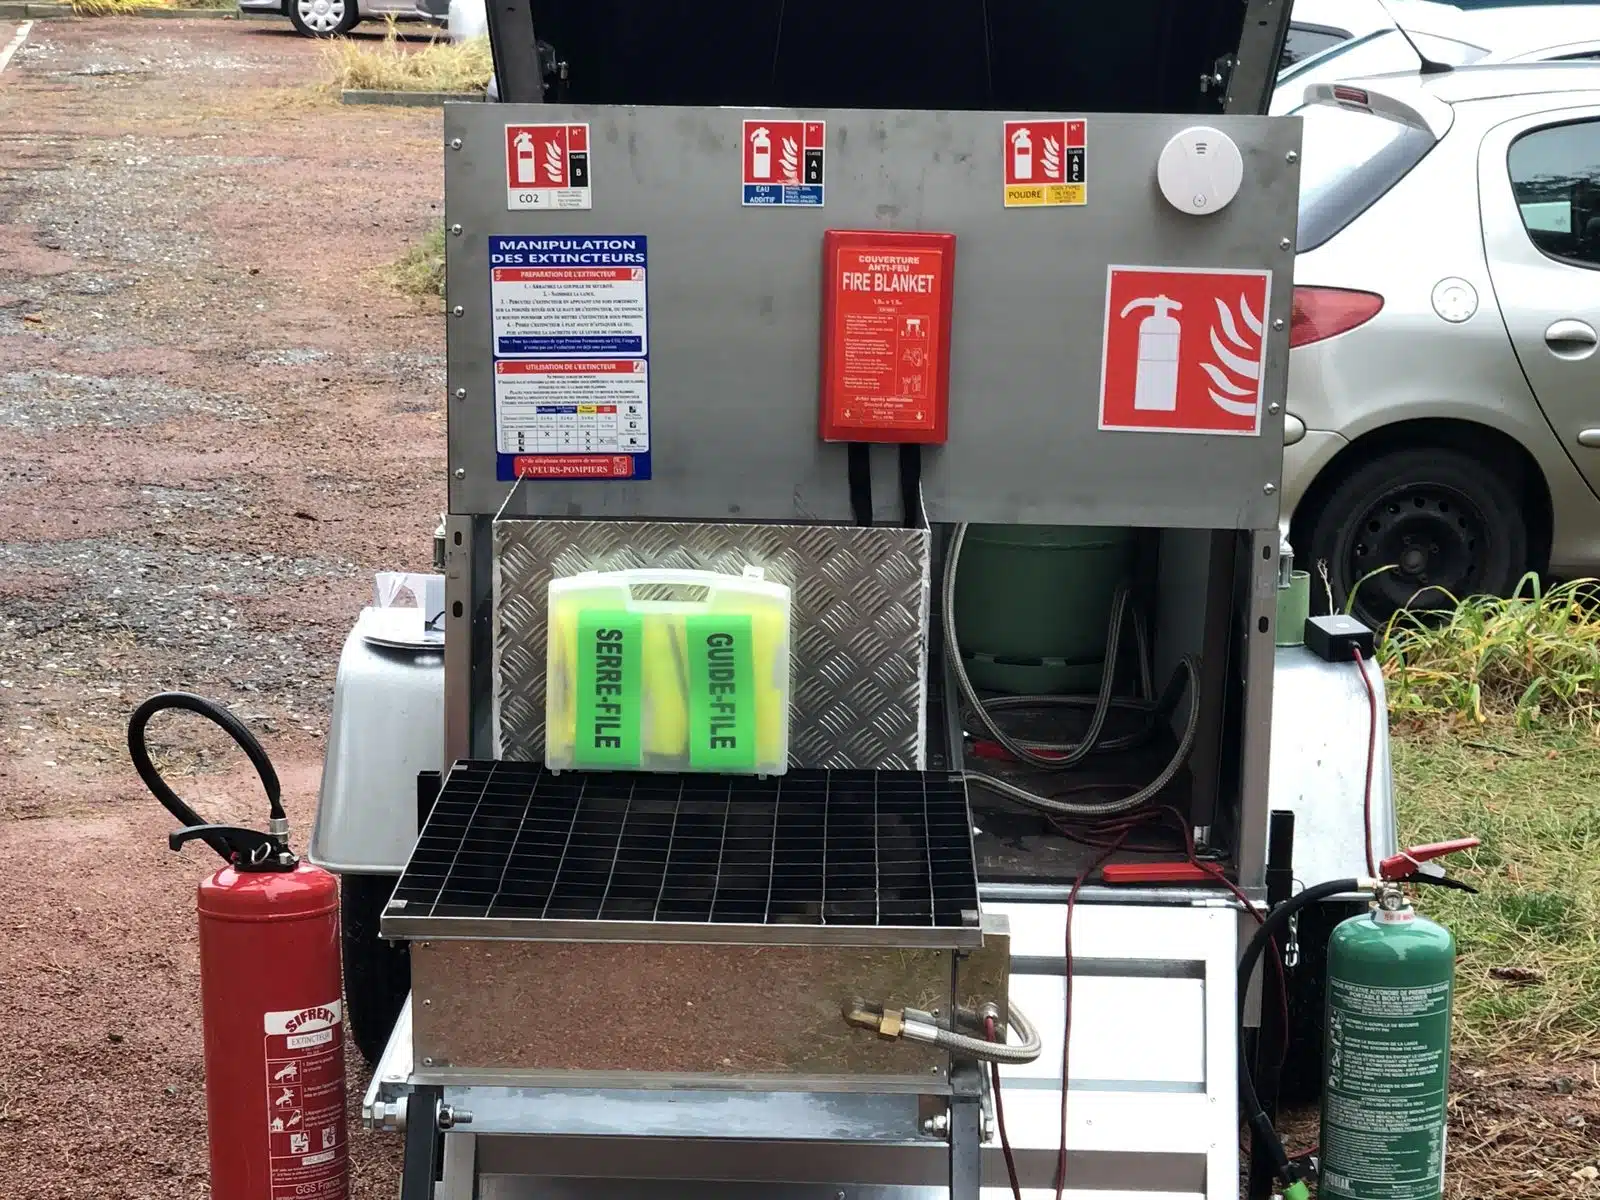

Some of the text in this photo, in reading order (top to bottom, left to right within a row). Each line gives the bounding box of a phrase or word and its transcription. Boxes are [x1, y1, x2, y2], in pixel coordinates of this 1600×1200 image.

[1072, 155, 1079, 163] A
[810, 160, 818, 168] A
[1072, 164, 1079, 172] B
[576, 168, 582, 176] B
[810, 171, 817, 180] B
[1072, 173, 1079, 182] C
[1008, 190, 1041, 198] POUDRE
[519, 194, 540, 204] CO2
[500, 240, 636, 250] MANIPULATION
[492, 253, 645, 264] DES EXTINCTEURS
[858, 255, 920, 264] COUVERTURE
[868, 264, 910, 272] ANTI-FEU
[842, 272, 935, 293] FIRE BLANKET
[594, 628, 623, 749] SERRE-FILE
[707, 633, 736, 749] GUIDE-FILE
[1349, 992, 1380, 1001] PORTABLE
[285, 1008, 335, 1032] SIFREXT
[292, 1032, 332, 1046] EXTINCTEUR
[296, 1184, 316, 1194] GGS
